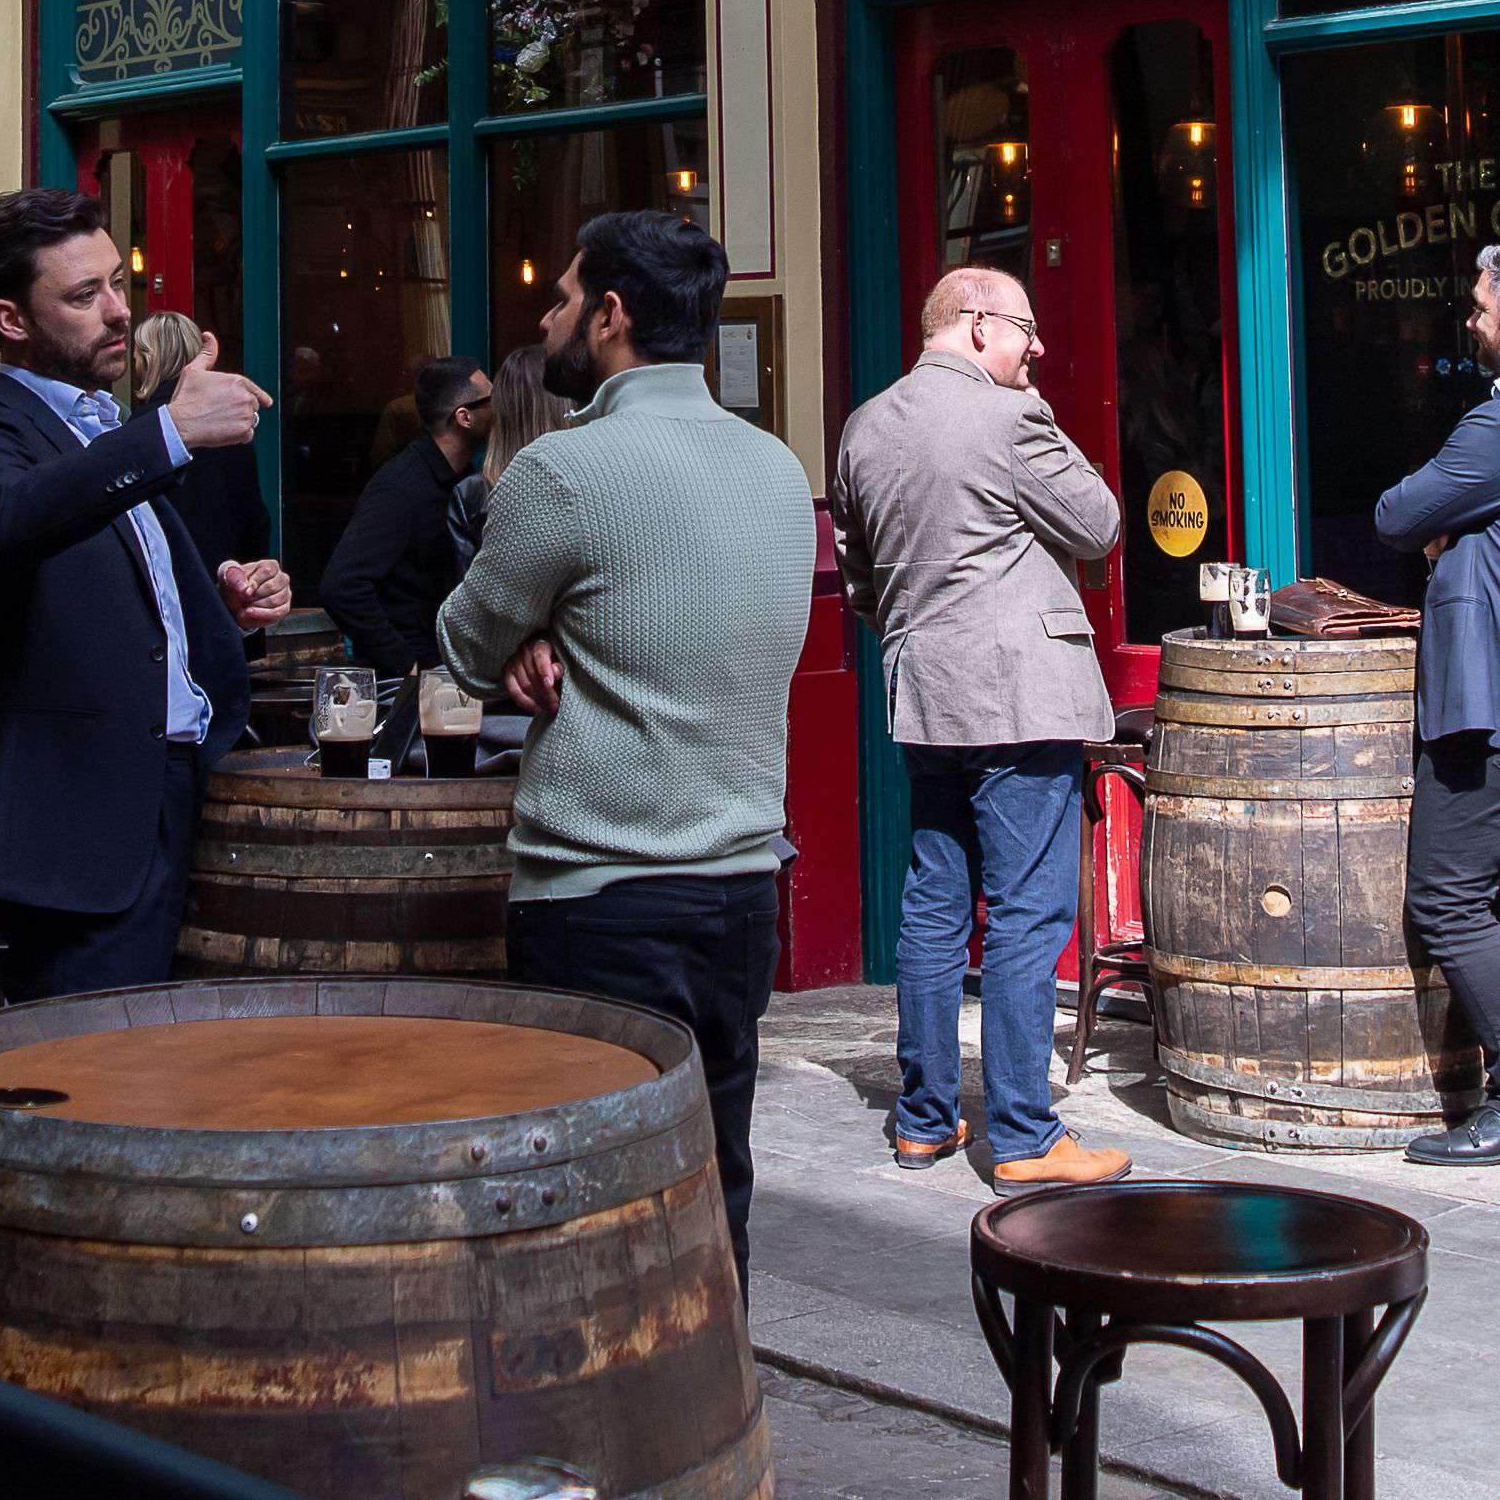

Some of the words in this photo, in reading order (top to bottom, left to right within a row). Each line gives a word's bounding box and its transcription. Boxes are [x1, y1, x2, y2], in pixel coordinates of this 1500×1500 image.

[1435, 158, 1497, 194] THE
[1321, 203, 1477, 279] GOLDEN
[1355, 277, 1449, 301] PROUDLY
[1169, 492, 1186, 510] NO
[1151, 509, 1205, 529] SMOKING
